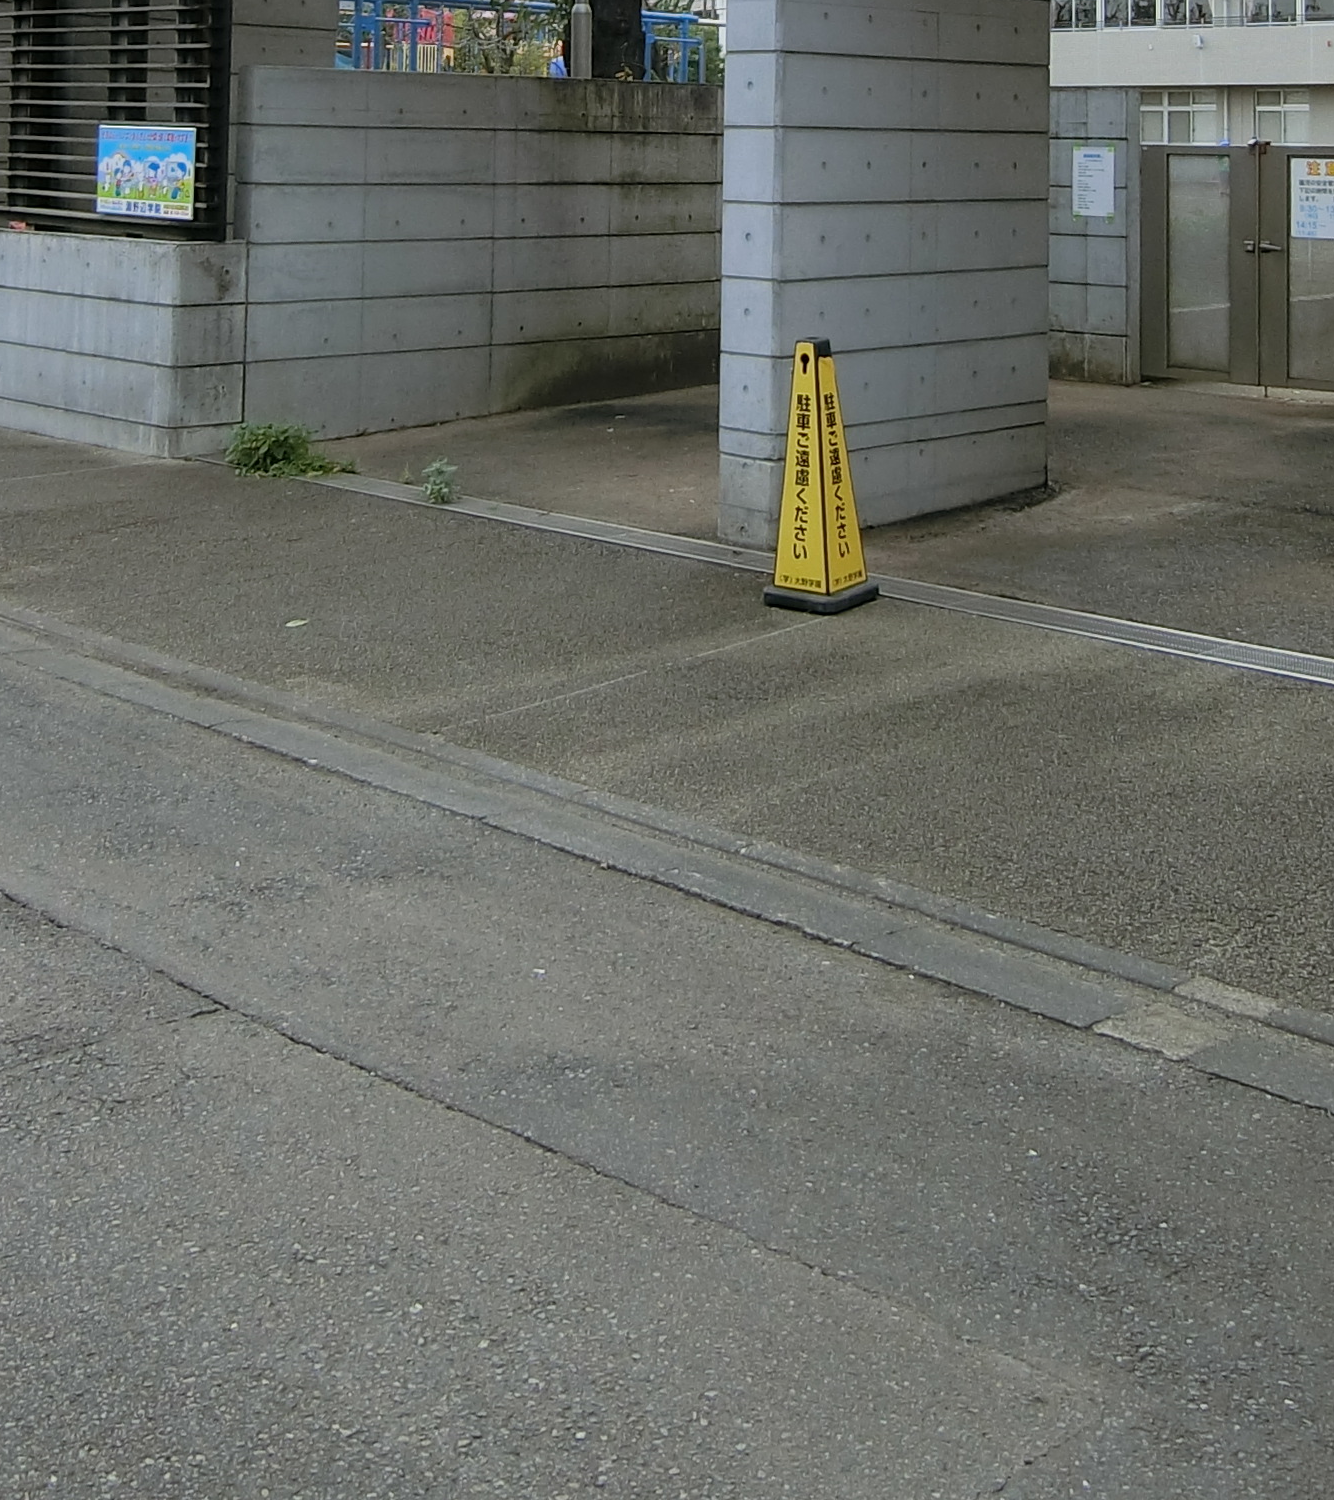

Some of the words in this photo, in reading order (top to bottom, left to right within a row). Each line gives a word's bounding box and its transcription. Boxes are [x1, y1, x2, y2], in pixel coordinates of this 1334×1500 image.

[792, 393, 811, 560] 駐車ご遠慮ください
[823, 391, 850, 559] 駐車ご遠慮ください
